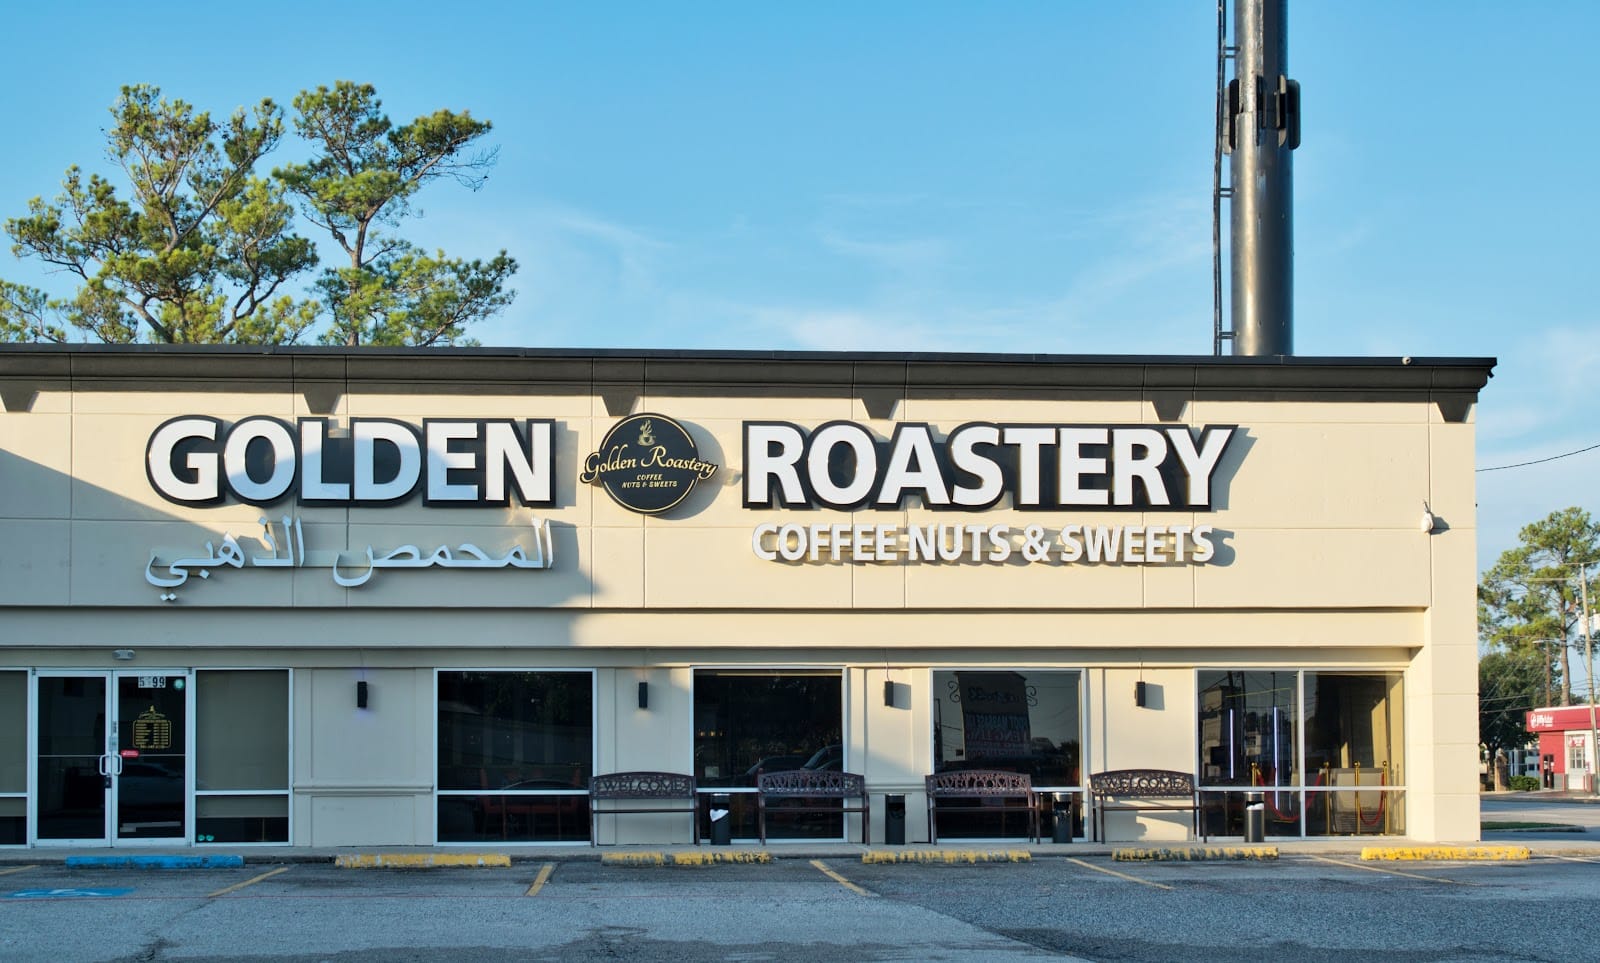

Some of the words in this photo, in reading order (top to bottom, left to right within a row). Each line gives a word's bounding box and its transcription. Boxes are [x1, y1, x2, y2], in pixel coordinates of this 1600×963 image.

[147, 417, 554, 504] GOLDEN
[580, 444, 637, 484] Golden
[641, 445, 718, 480] Roastery
[744, 422, 1236, 508] ROASTERY
[144, 516, 305, 602] الذهبي
[332, 516, 554, 587] المحمص
[752, 523, 897, 562] COFFEE
[908, 524, 1012, 562] NUTS
[1021, 524, 1051, 562] &
[1060, 524, 1215, 563] SWEETS
[604, 780, 683, 792] WELCOME
[771, 777, 853, 789] WELCOME
[938, 777, 1020, 789] WELCOME
[1105, 776, 1184, 789] WELCOME
